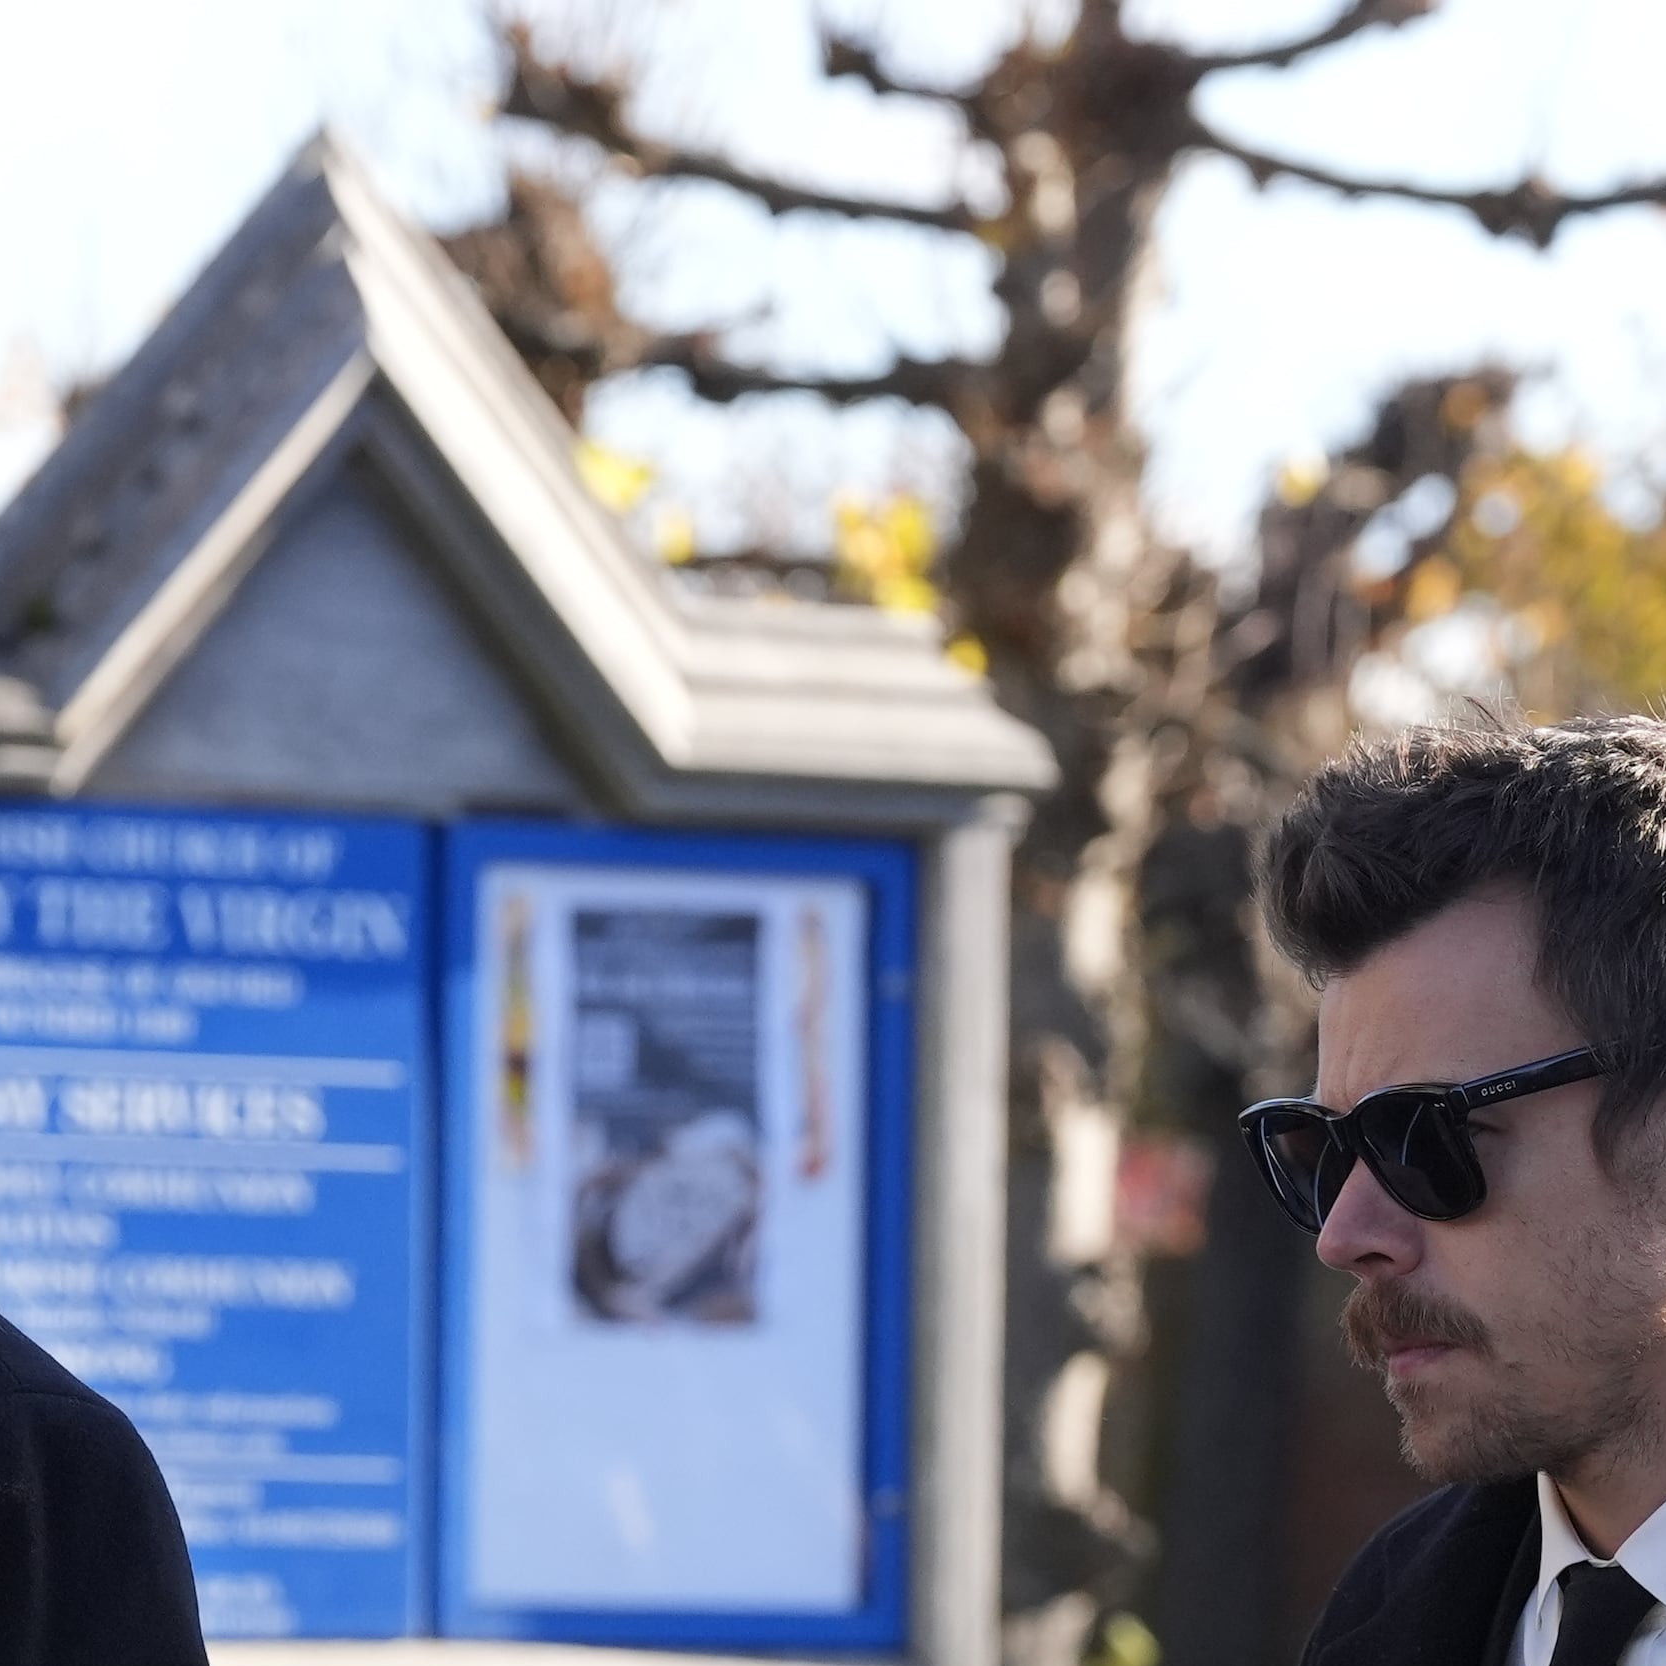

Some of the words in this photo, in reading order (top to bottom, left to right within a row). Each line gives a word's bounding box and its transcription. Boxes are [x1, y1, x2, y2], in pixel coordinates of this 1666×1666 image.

[29, 878, 168, 948] THE
[176, 885, 410, 959] VIRGIN
[61, 1073, 322, 1143] SERVICES
[1481, 1080, 1516, 1097] GUCCI
